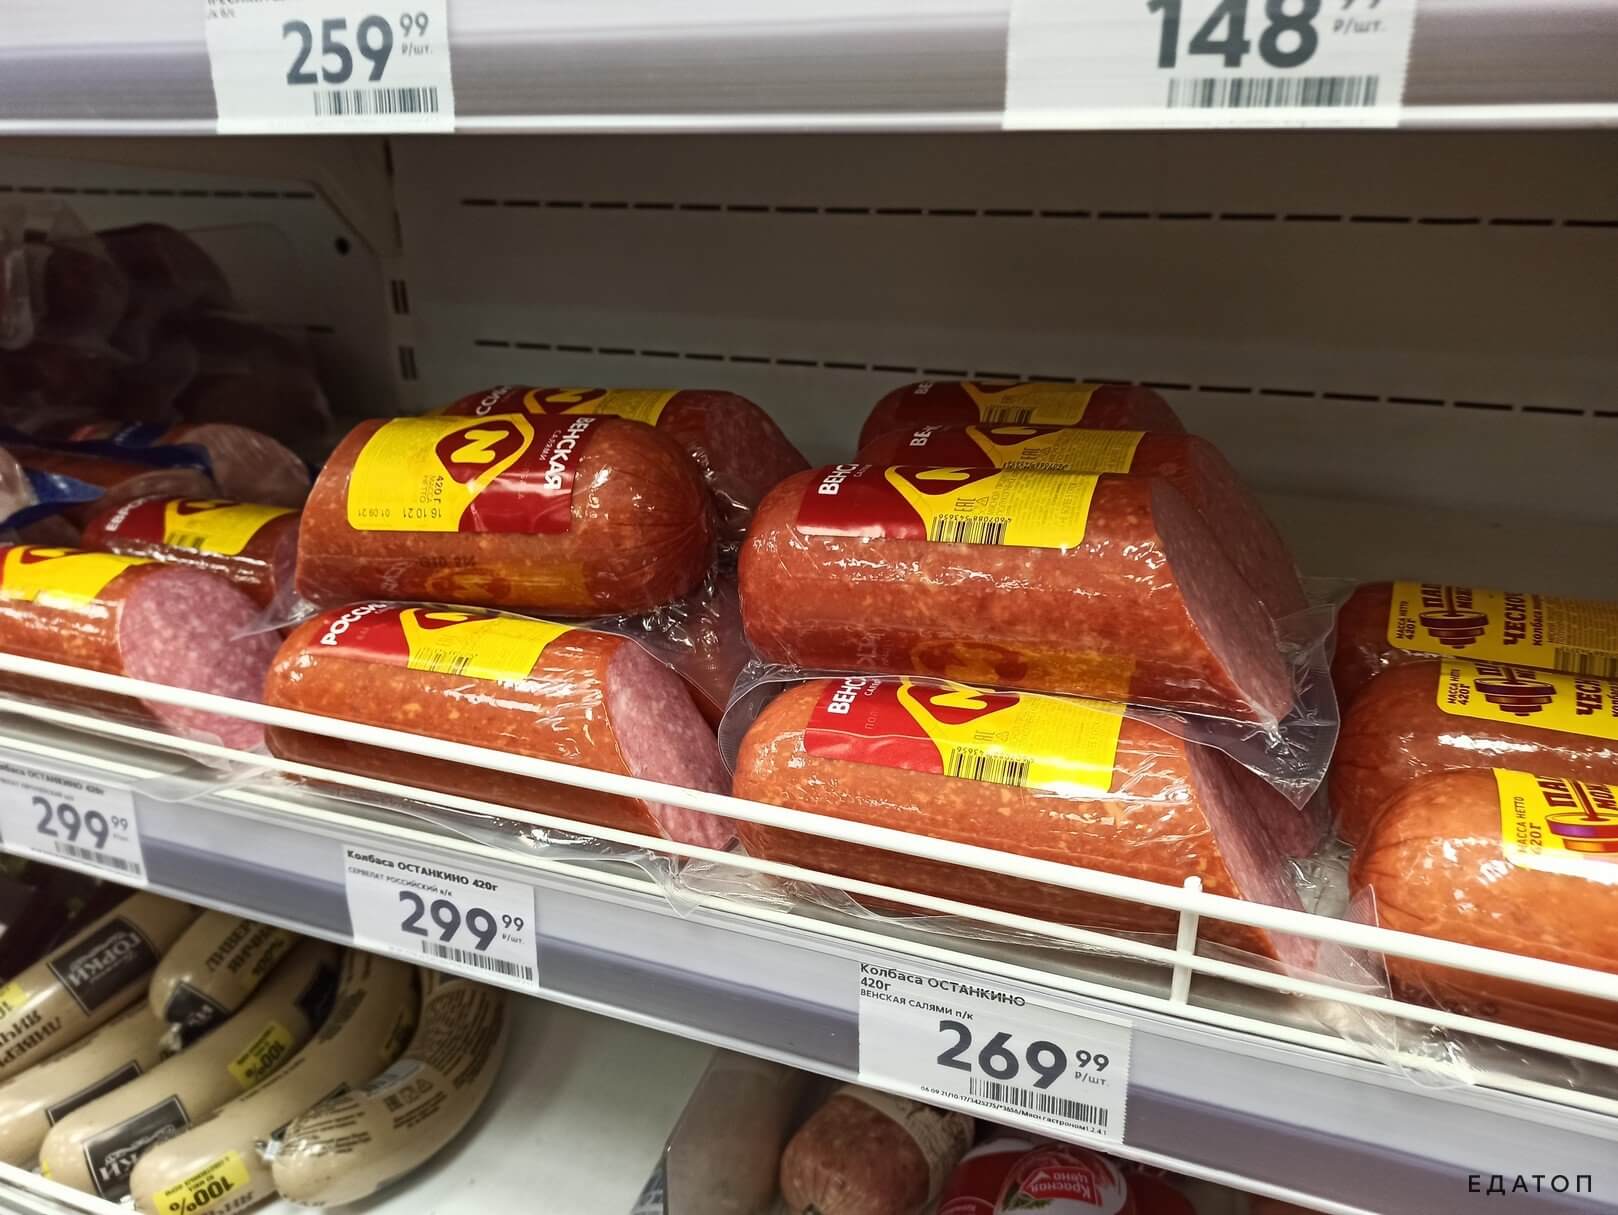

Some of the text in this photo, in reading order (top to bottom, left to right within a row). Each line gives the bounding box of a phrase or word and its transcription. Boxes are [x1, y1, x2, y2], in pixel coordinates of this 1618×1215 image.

[282, 12, 429, 86] 259 99
[1147, 0, 1322, 69] 148
[543, 416, 596, 490] ВЕНСКАЯ
[818, 463, 860, 496] ВЕНС
[827, 676, 866, 715] ВЕНС
[32, 796, 129, 849] 299 99
[347, 850, 498, 892] Колбаса ОСТАНКИНО 420г
[386, 875, 438, 894] РОССИЙСКИЙ
[399, 890, 525, 952] 299 99
[67, 932, 142, 987] ГОРКИ
[860, 976, 892, 993] 420г
[860, 962, 1026, 1008] Колбаса ОСТАНКИНО
[860, 988, 974, 1021] ВЕНСКАЯ САЛЯМИ п/к
[937, 1020, 1110, 1089] 269 99
[168, 1174, 235, 1215] 100%
[1031, 1181, 1091, 1199] Красная
